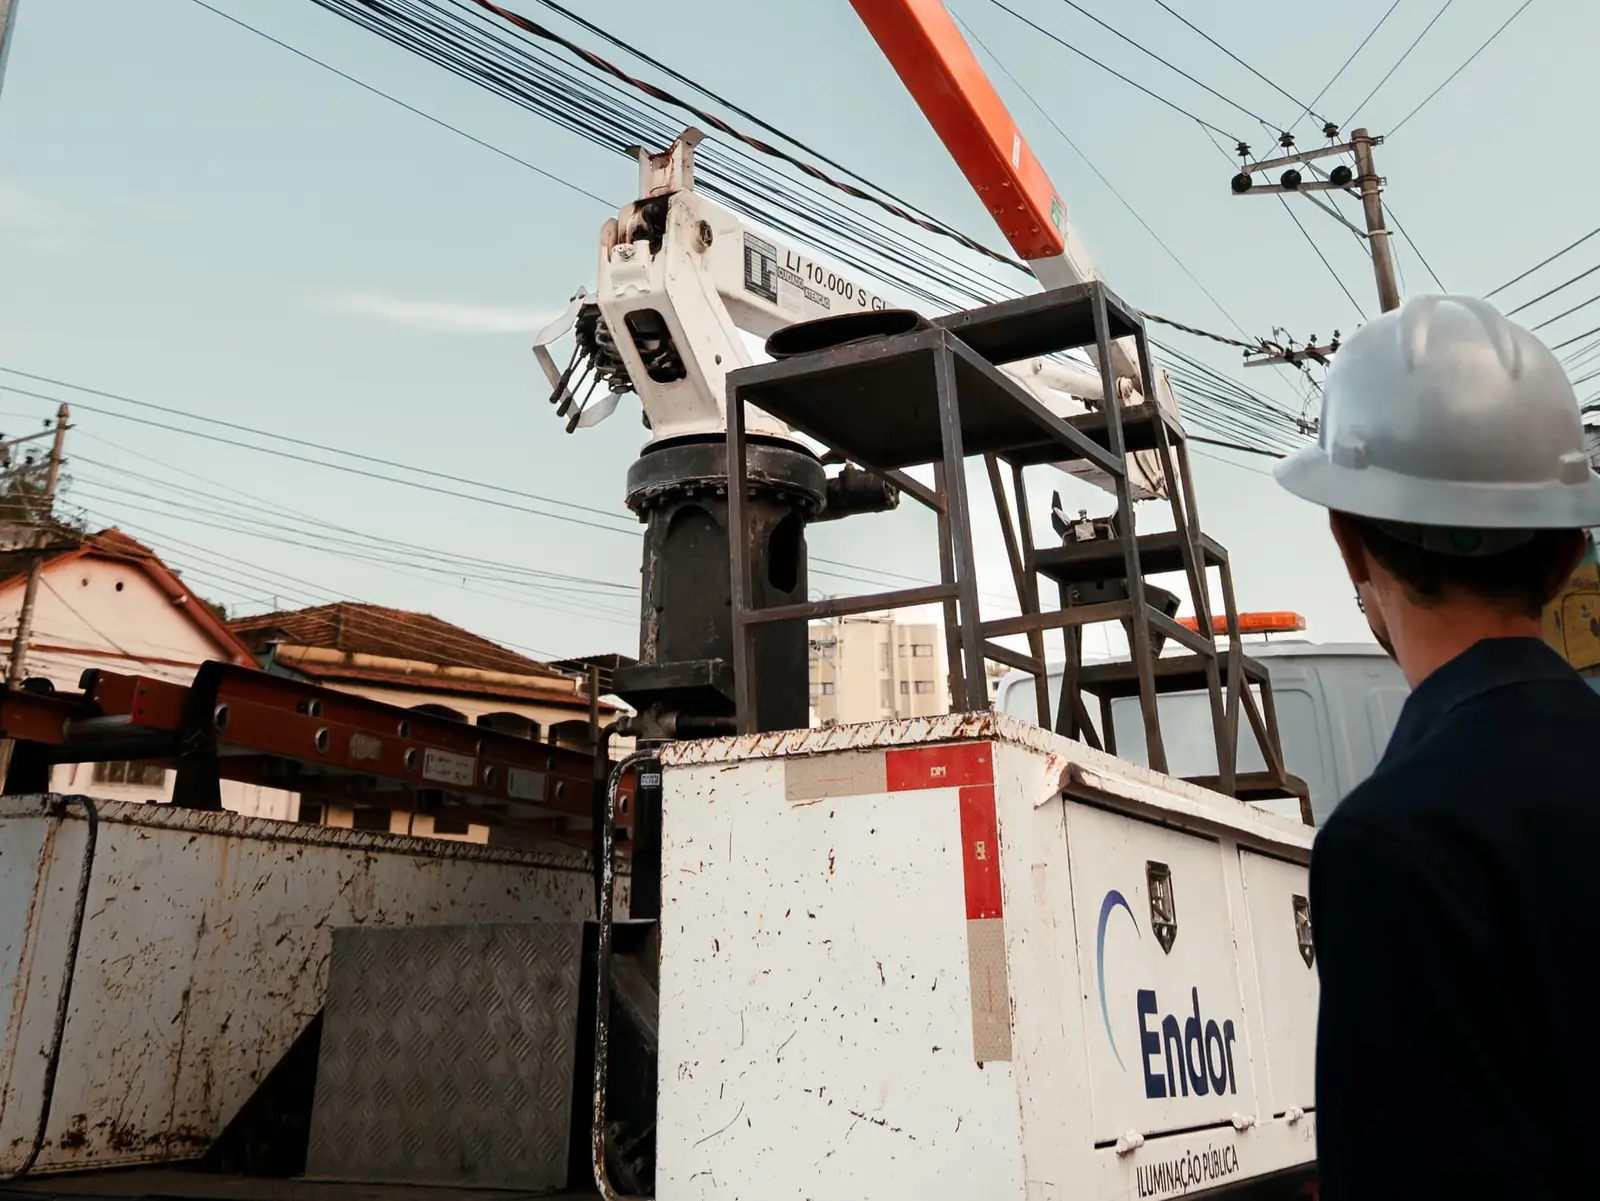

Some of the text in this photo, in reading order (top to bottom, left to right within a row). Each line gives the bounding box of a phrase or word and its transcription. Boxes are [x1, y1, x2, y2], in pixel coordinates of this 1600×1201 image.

[786, 250, 801, 274] LI
[806, 262, 853, 300] 10.000
[857, 288, 867, 308] S
[1137, 986, 1236, 1099] Endor
[1136, 1143, 1239, 1199] ILUMINAÇÃO PÚBLICA
